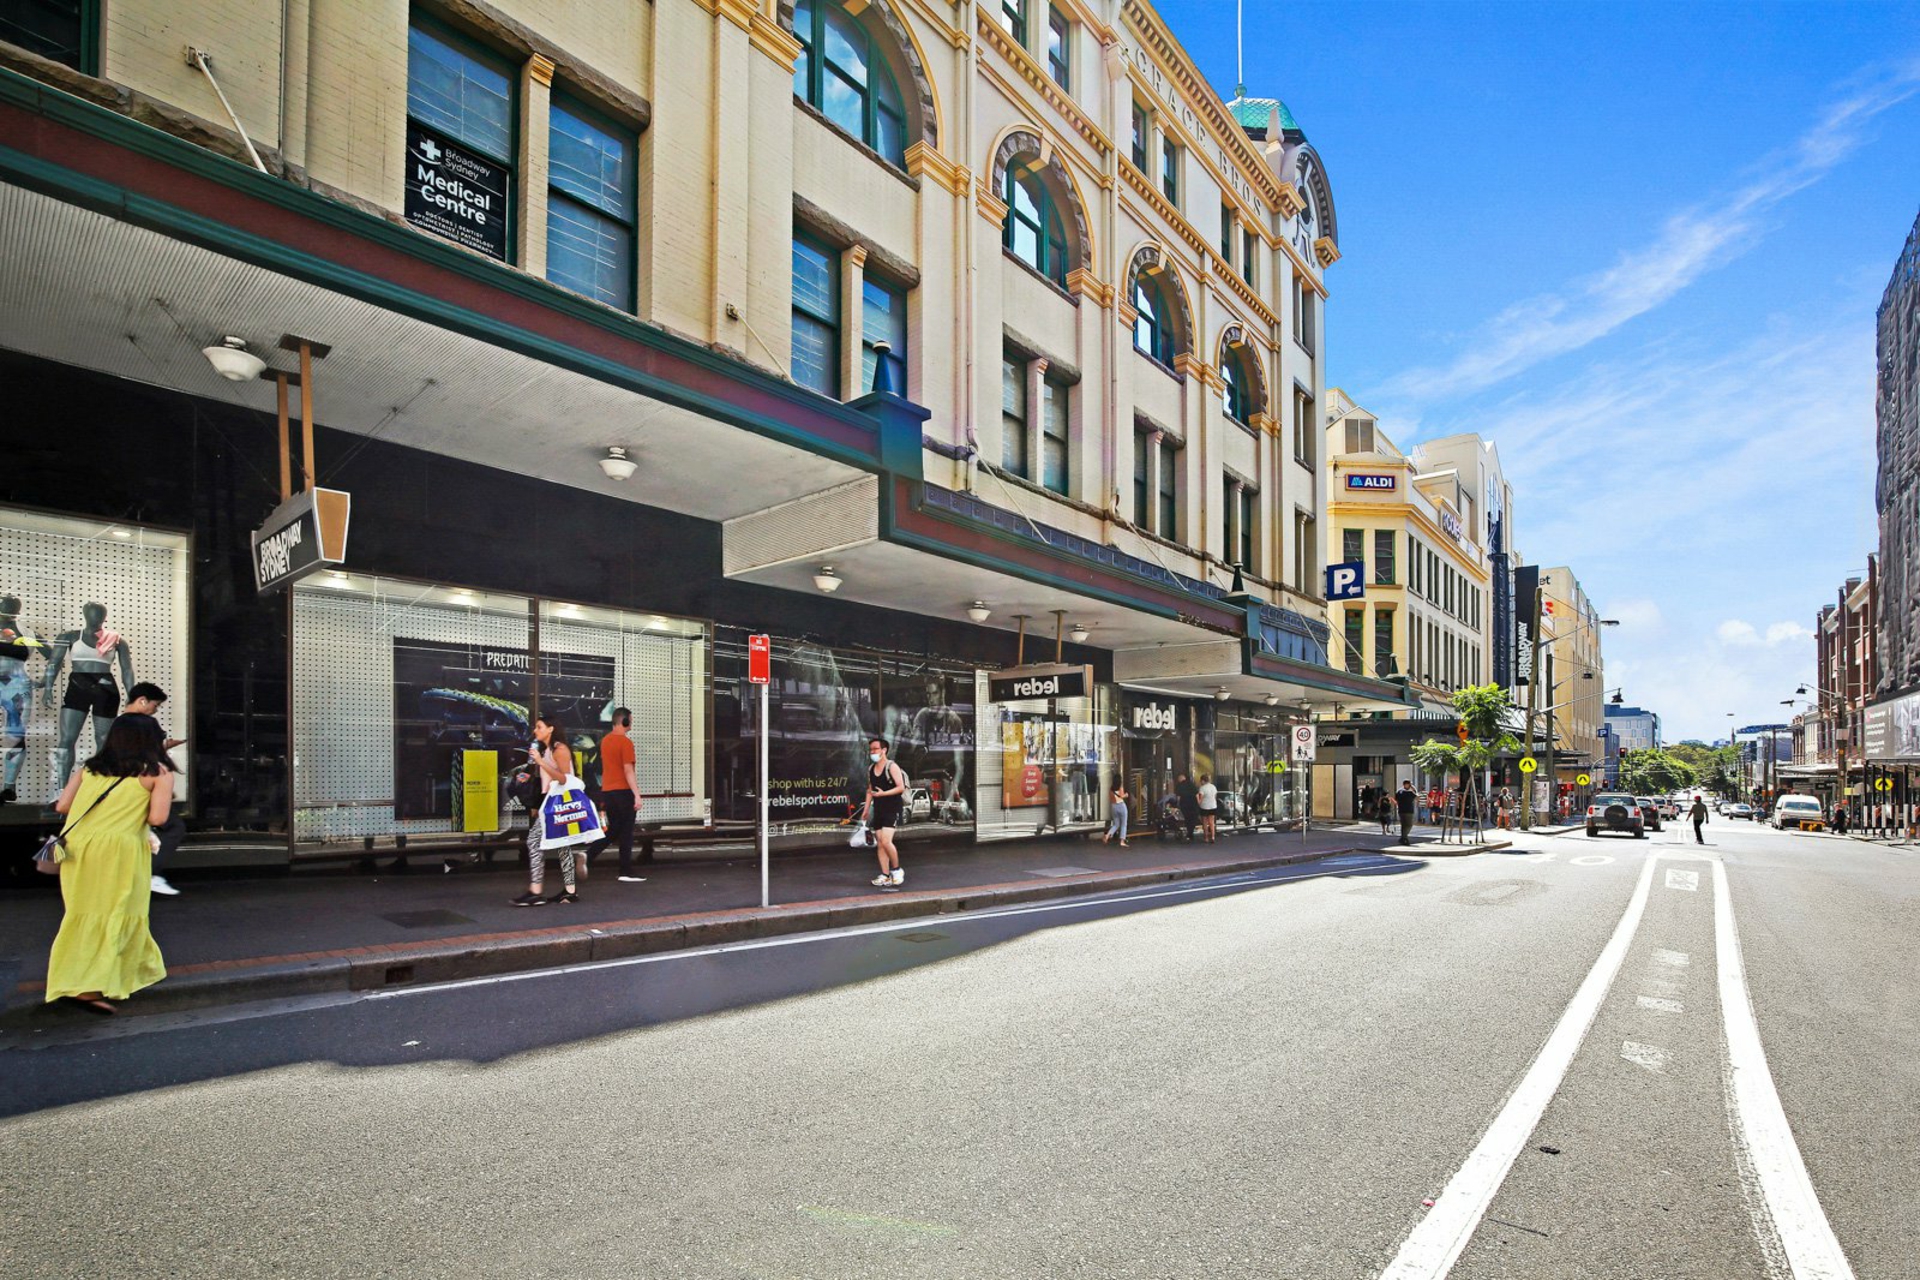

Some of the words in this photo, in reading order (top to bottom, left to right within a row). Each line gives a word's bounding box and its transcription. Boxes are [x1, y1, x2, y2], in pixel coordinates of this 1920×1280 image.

[445, 148, 491, 177] Broadway
[445, 158, 479, 181] Sydney
[418, 164, 490, 210] Medical
[1219, 150, 1261, 216] BROS
[421, 184, 486, 225] Centre
[413, 211, 456, 233] OPTOMETRIST
[460, 232, 494, 249] PATHOLOGY
[425, 211, 454, 227] DOCTORS
[459, 225, 484, 239] DENTIST
[460, 238, 492, 254] PHARMACY
[1364, 477, 1393, 487] ALDI
[260, 520, 302, 561] BROADWAY
[260, 548, 291, 583] SYDNEY
[1333, 568, 1356, 595] P
[1518, 621, 1527, 677] BROADWAY
[1013, 675, 1059, 697] rebel
[1134, 702, 1176, 729] rebel
[1299, 730, 1308, 739] 40
[768, 778, 792, 790] shop
[794, 778, 814, 789] with
[816, 780, 826, 788] us
[827, 777, 848, 788] 24/7
[768, 794, 848, 808] rebelsport.com
